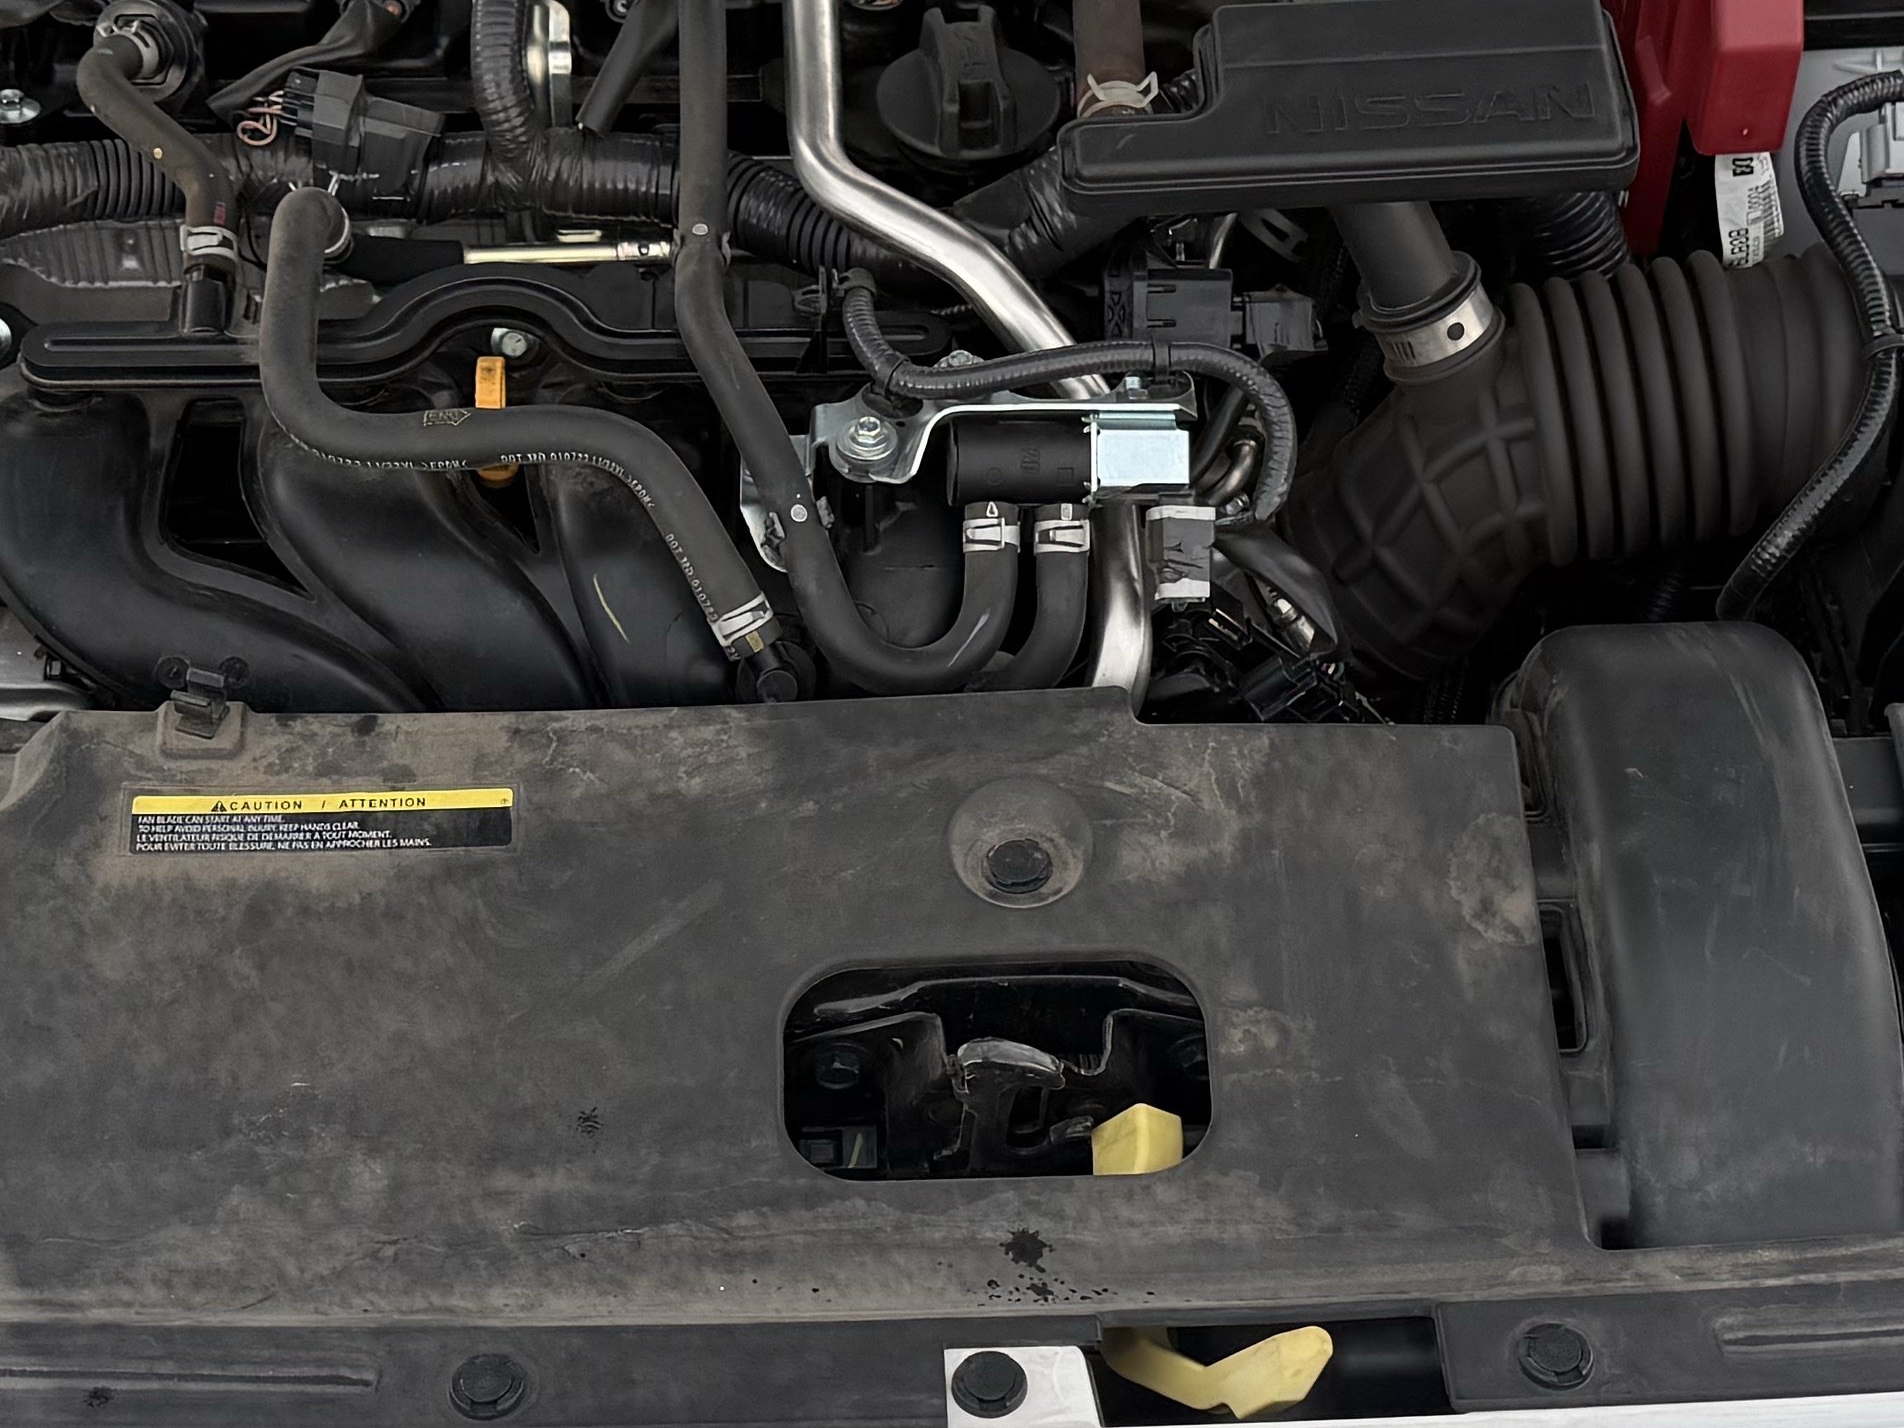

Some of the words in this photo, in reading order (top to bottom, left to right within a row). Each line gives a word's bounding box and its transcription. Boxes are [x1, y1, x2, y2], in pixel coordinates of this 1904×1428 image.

[1263, 80, 1597, 136] NISSAN
[229, 800, 302, 811] CAUTION
[339, 797, 426, 809] ATTENTION
[185, 815, 204, 823] CAN
